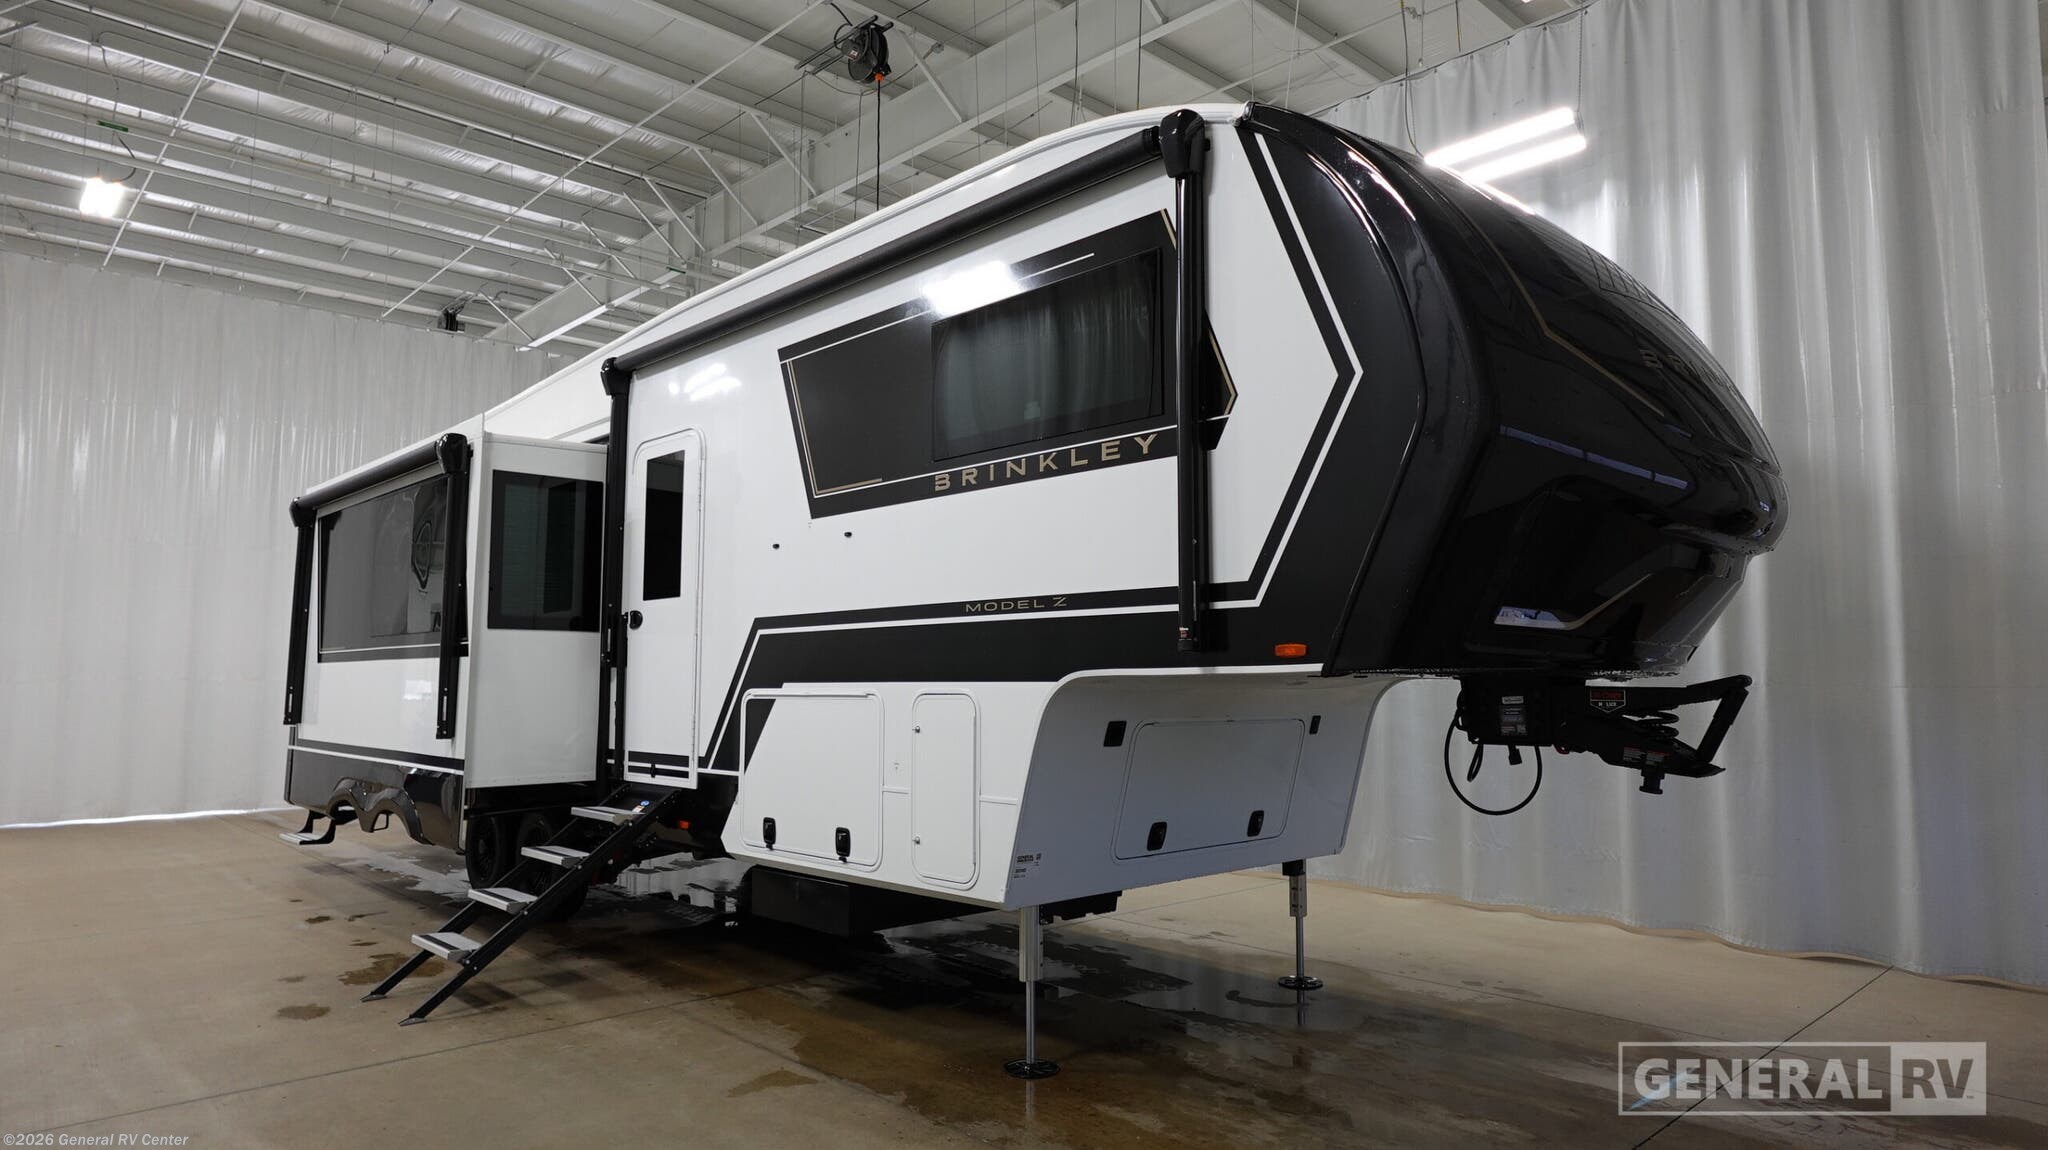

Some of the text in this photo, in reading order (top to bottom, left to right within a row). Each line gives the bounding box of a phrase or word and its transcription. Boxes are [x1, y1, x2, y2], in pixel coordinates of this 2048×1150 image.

[935, 434, 1158, 492] BRINKLEY
[965, 596, 1067, 613] MODEL Z
